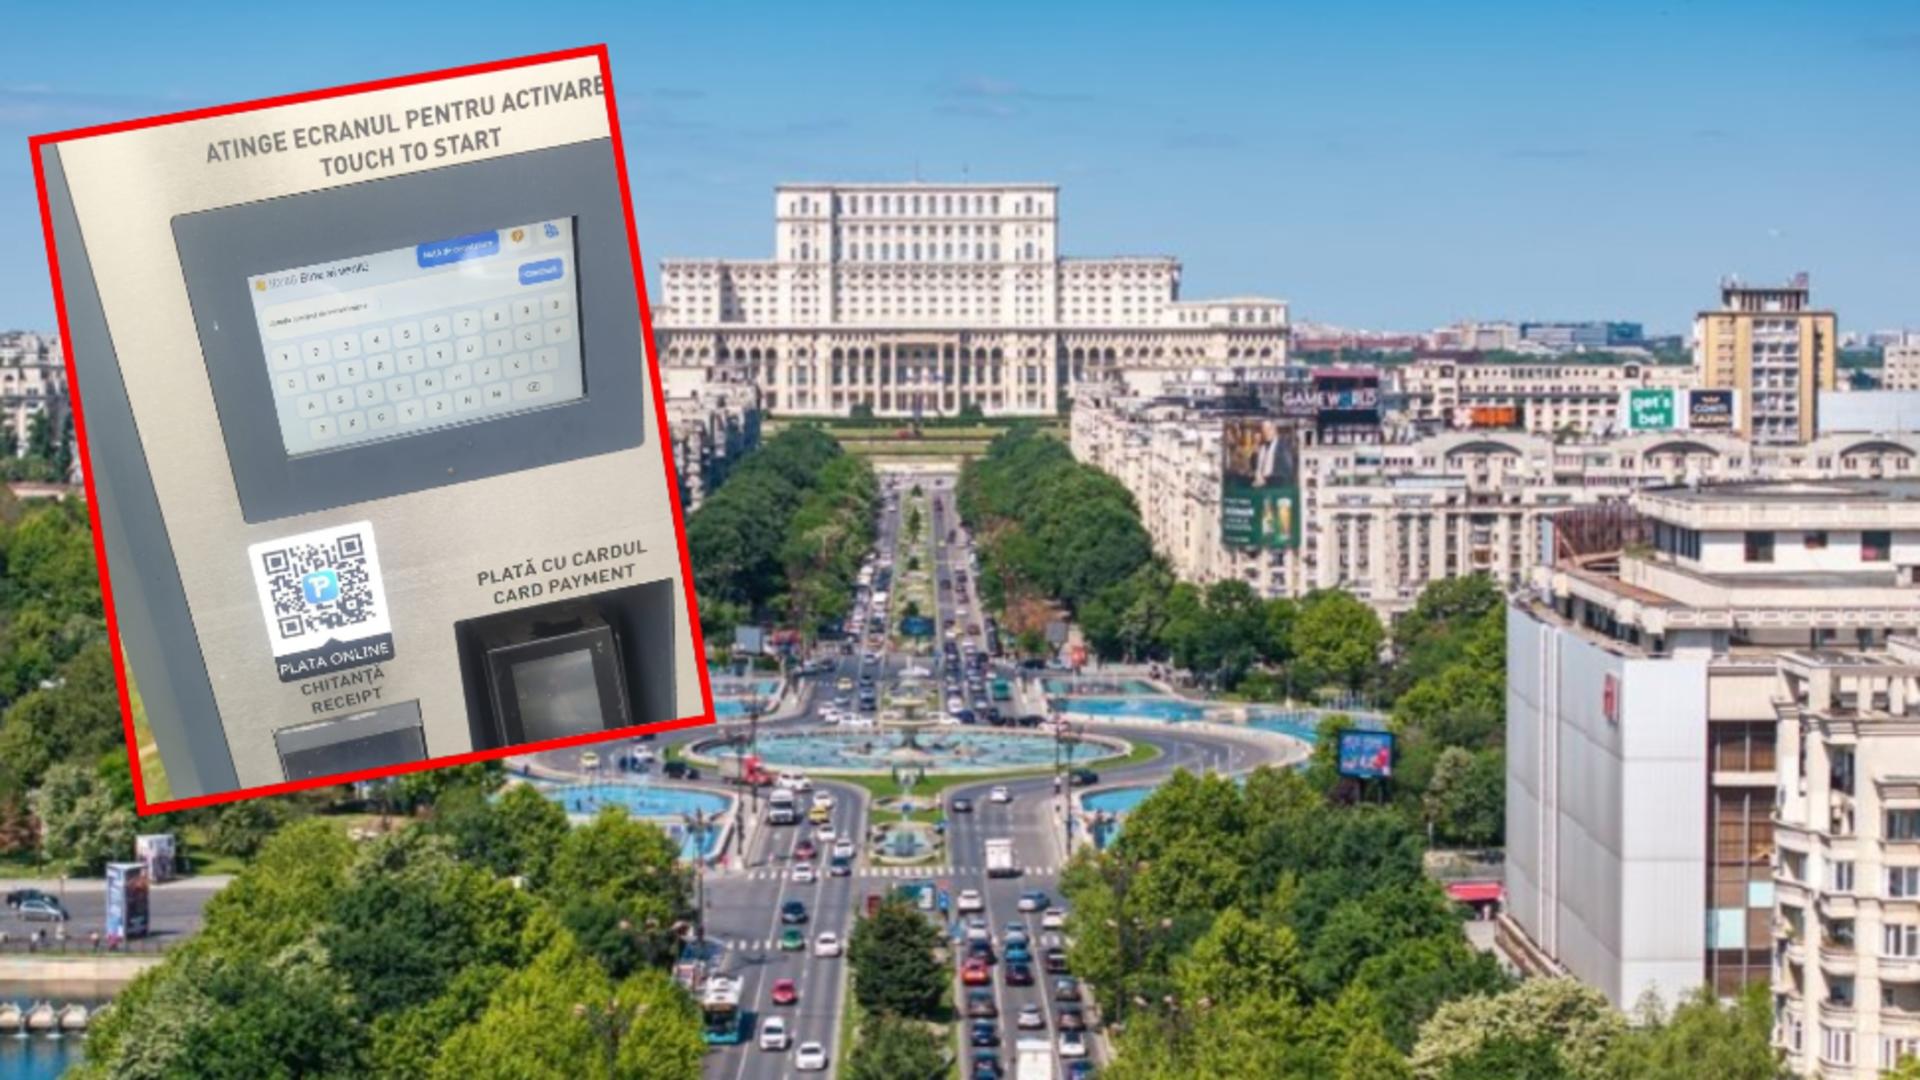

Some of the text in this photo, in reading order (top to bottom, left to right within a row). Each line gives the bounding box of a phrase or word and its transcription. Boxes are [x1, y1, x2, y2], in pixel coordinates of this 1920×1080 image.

[206, 75, 605, 164] ATINGE ECRANUL PENTRU ACTIVARE
[319, 127, 502, 178] TOUCH TO START
[477, 539, 648, 586] PLATĂ CU CARDUL
[493, 563, 636, 605] CARD PAYMENT
[280, 642, 390, 676] PLATA ONLINE
[311, 686, 382, 715] RECEIPT
